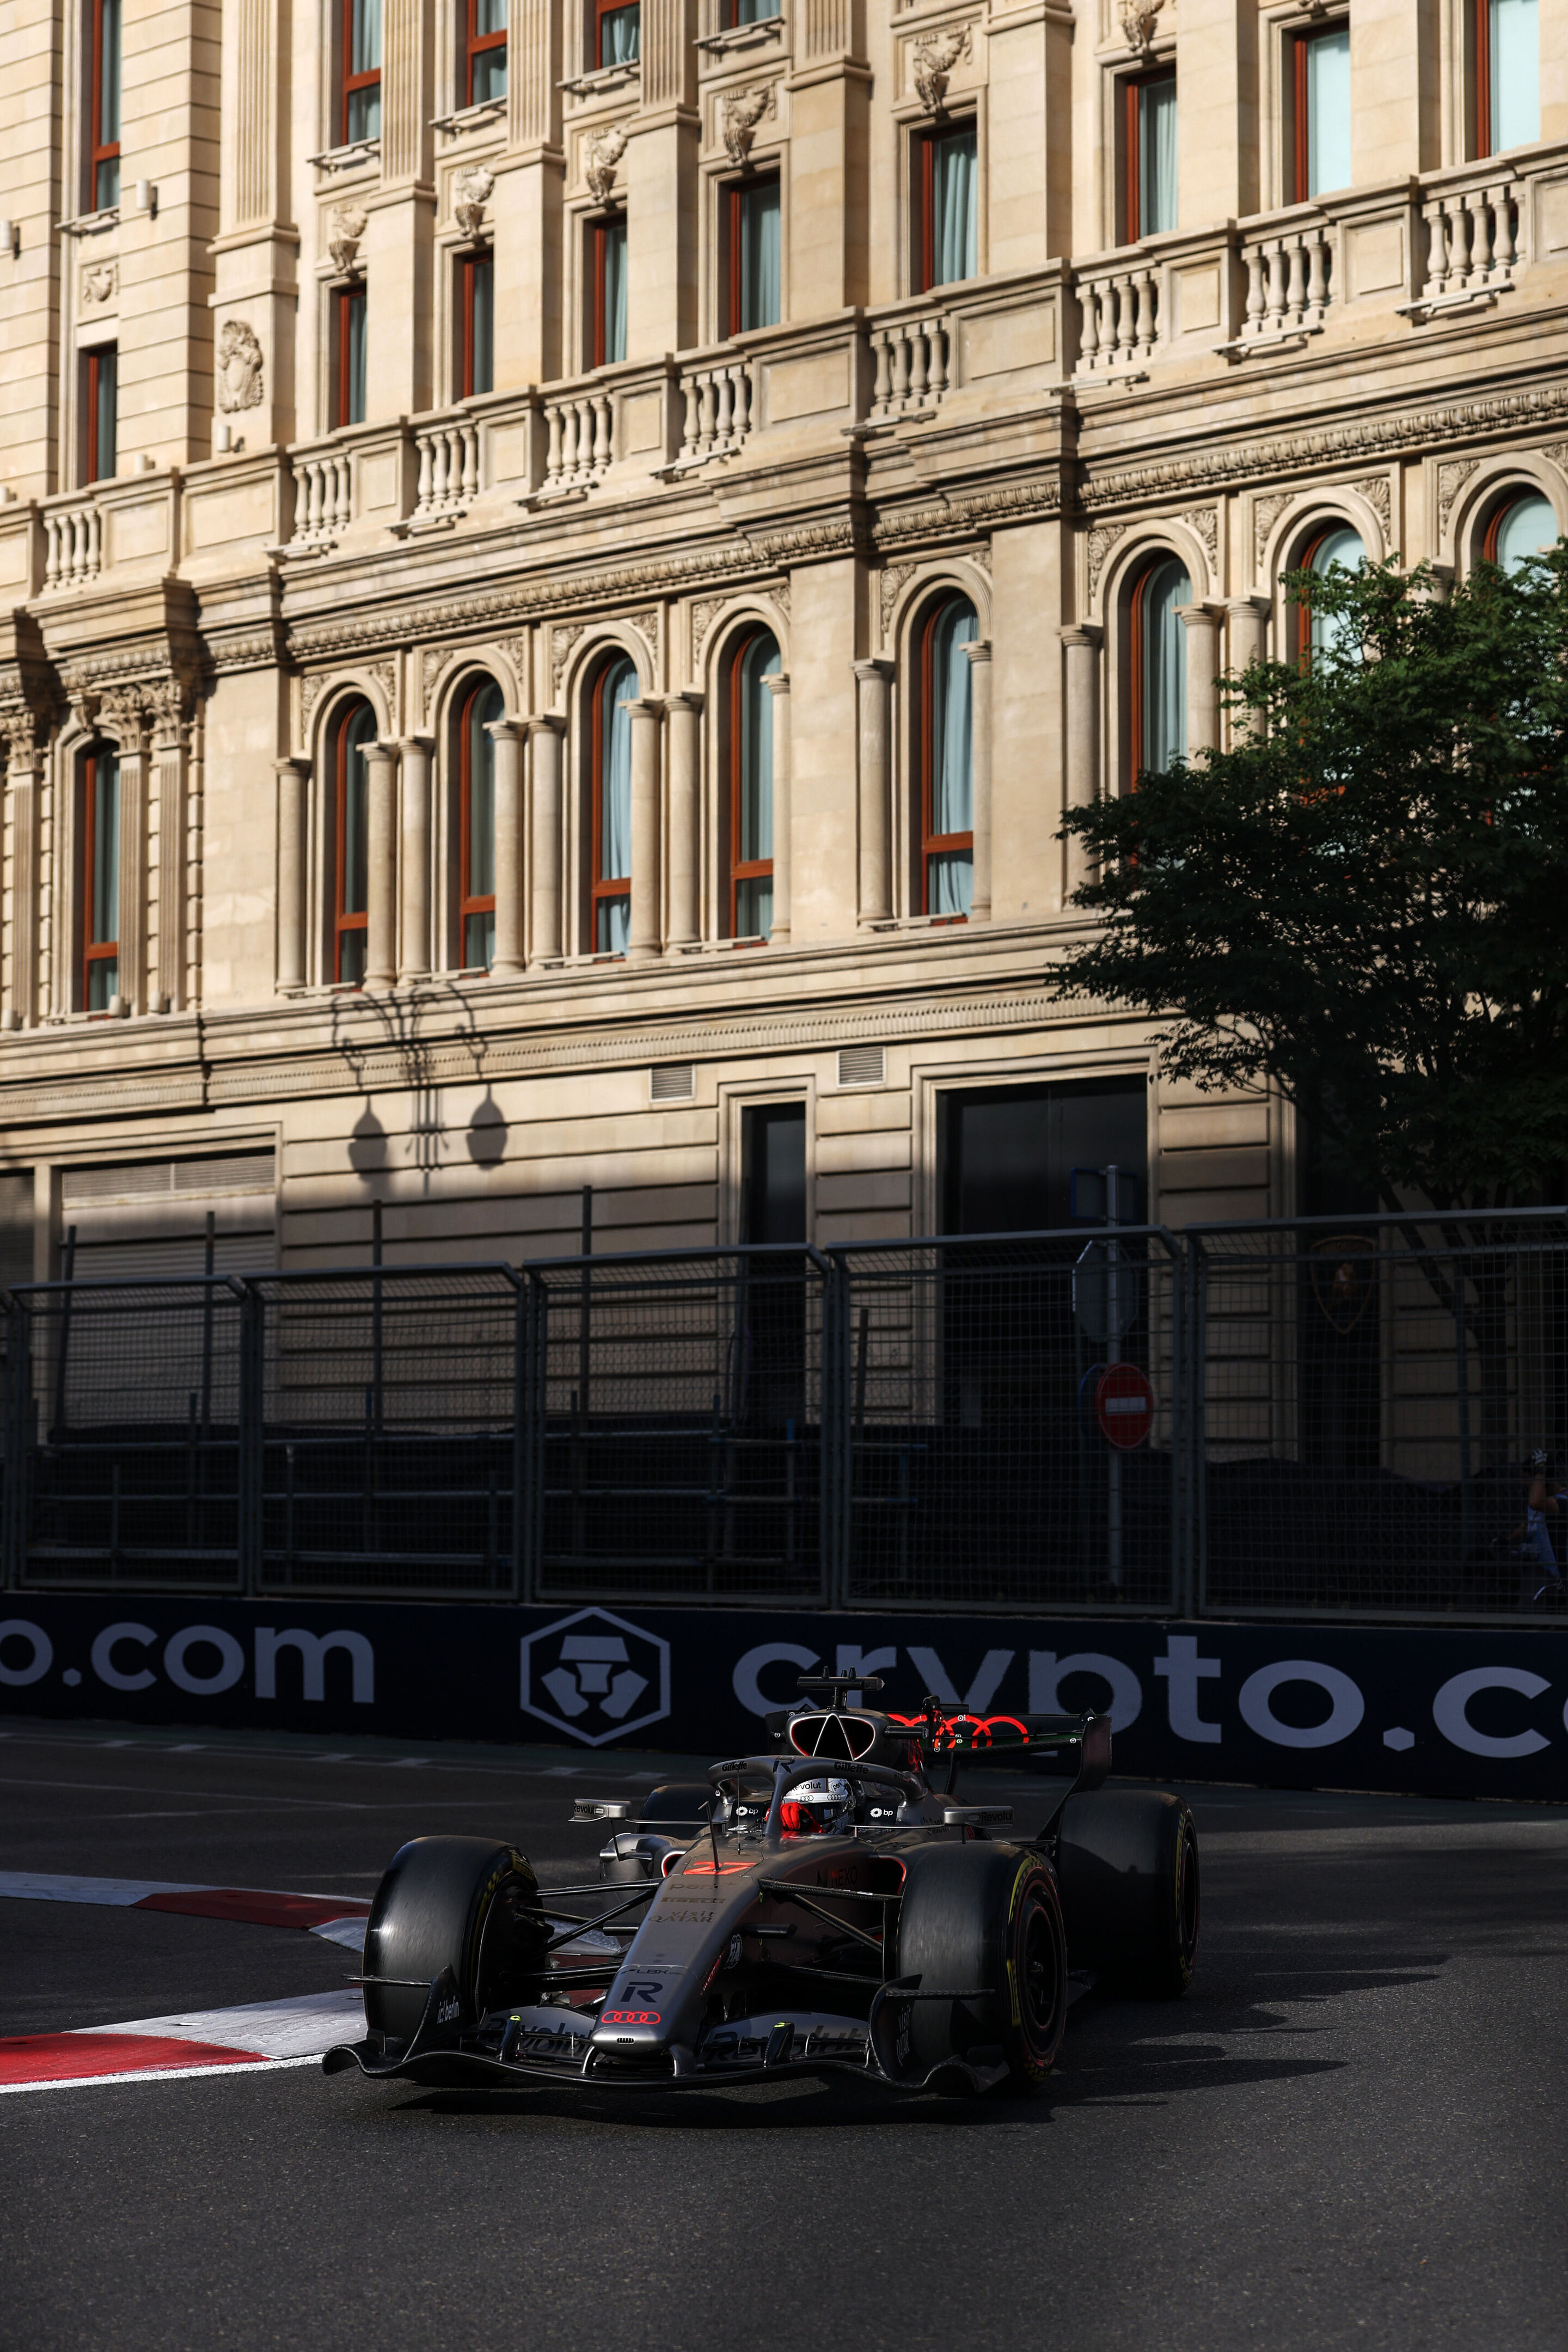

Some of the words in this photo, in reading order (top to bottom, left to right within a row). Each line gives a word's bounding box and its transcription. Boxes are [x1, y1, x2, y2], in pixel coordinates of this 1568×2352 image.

[732, 1633, 1568, 1759] crypto.c
[722, 1761, 748, 1771] Gillette
[834, 1762, 869, 1774] Gillette
[574, 1803, 595, 1814] Revolut
[981, 1811, 1012, 1822] Revolu
[683, 1861, 757, 1875] 27
[831, 1866, 857, 1887] NEXO
[620, 1982, 663, 2003] R
